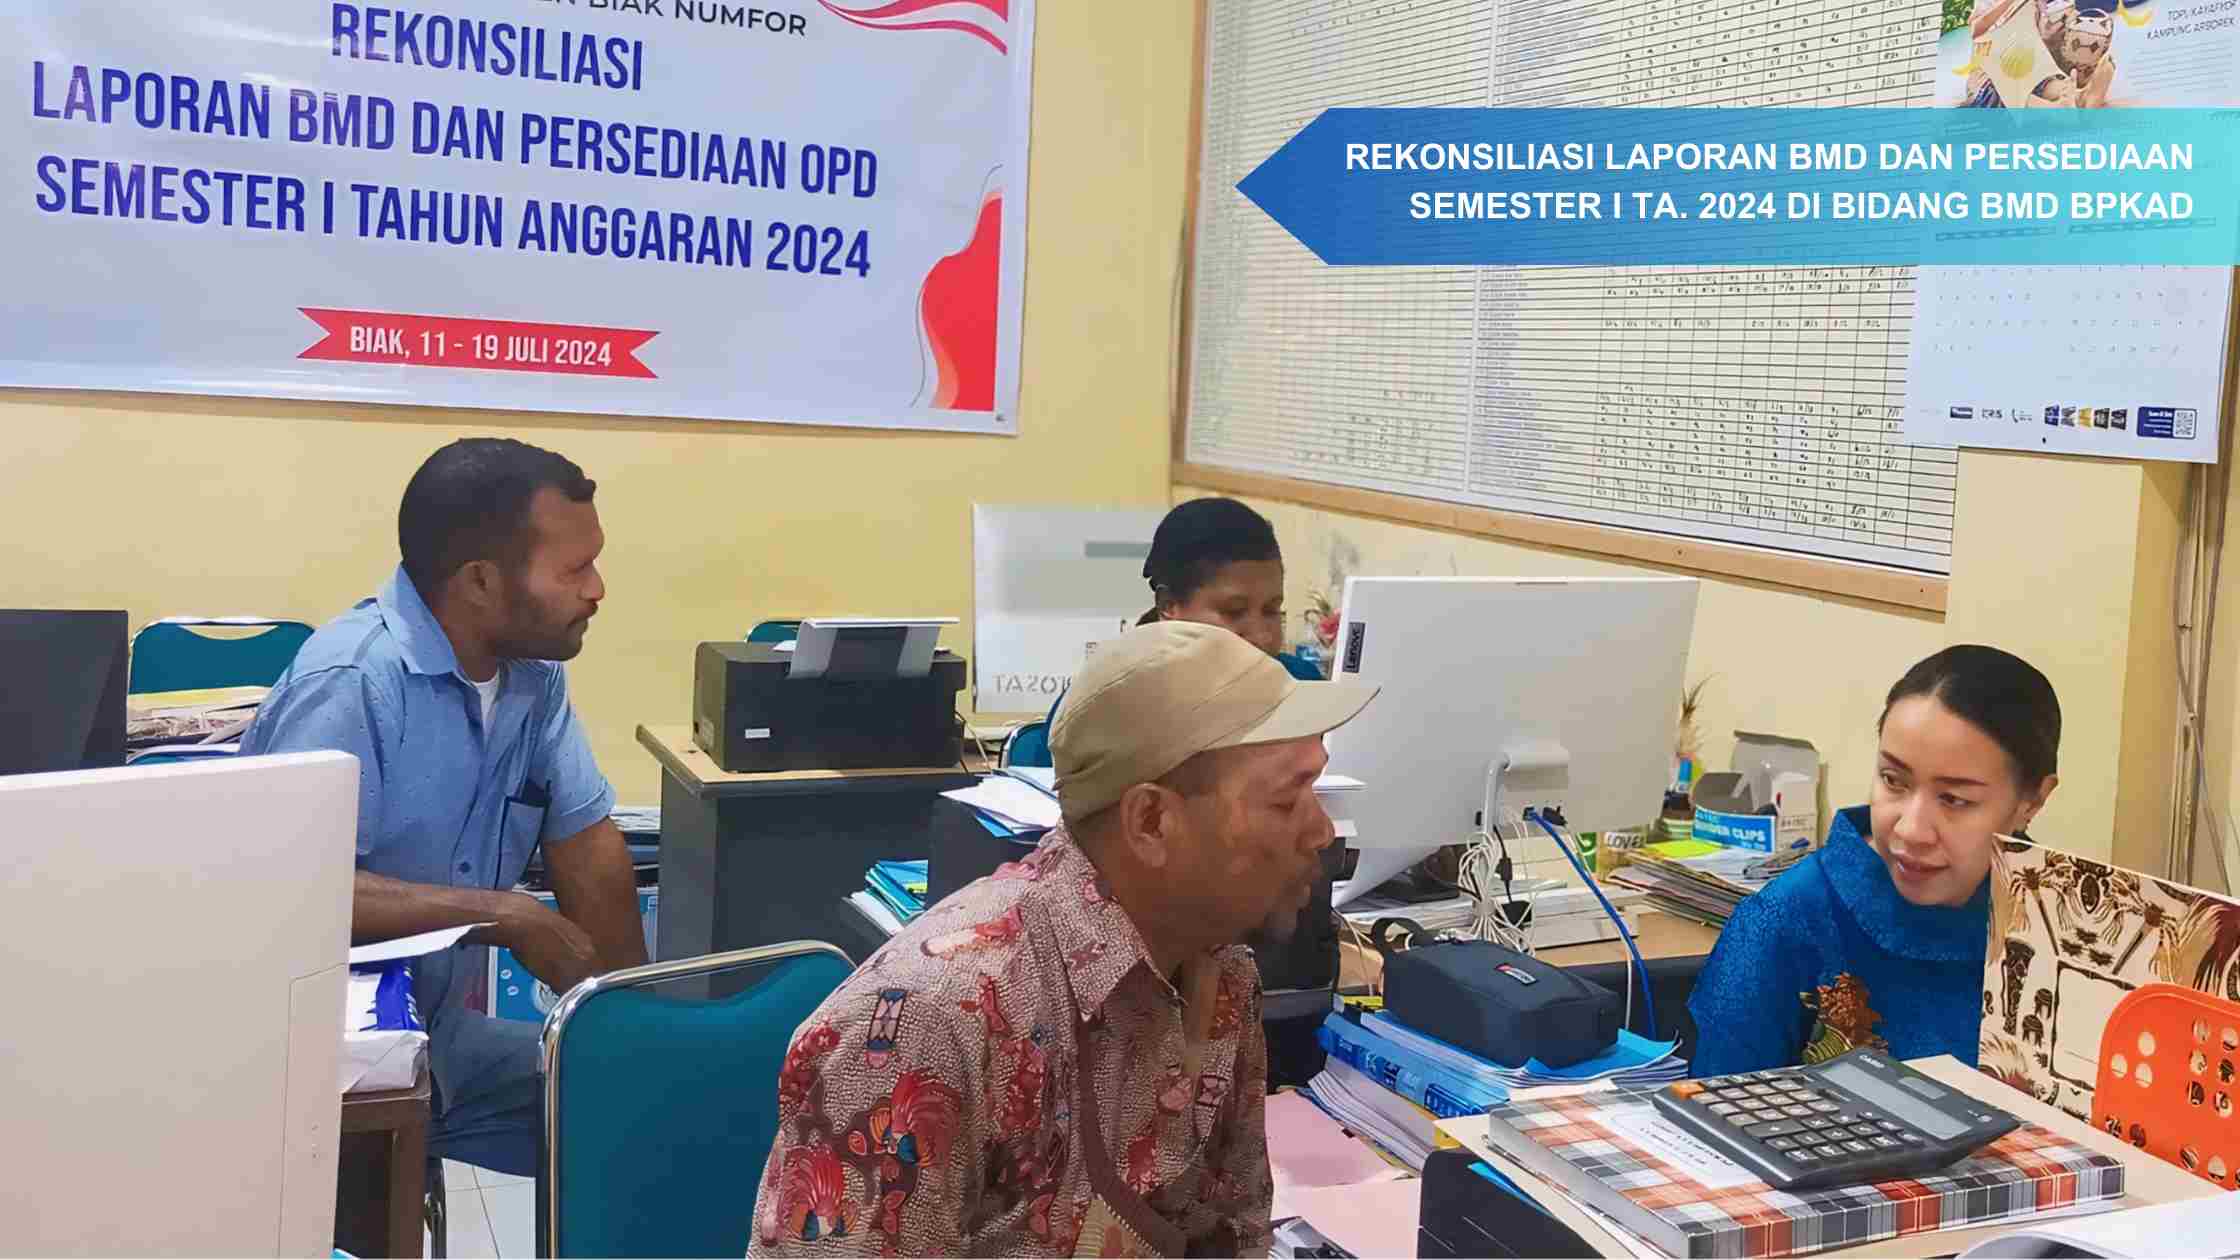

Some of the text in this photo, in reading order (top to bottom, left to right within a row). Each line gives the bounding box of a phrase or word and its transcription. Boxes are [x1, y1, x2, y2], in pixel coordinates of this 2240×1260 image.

[331, 2, 643, 91] REKONSILIASI
[675, 0, 807, 36] NUMFOR
[33, 62, 878, 199] LAPORAN BMD DAN PERSEDIAAN OPD
[35, 155, 871, 278] SEMESTER I TAHUN ANGGARAN 2024
[350, 326, 410, 358] BIAK,
[420, 331, 445, 357] 11
[473, 334, 498, 360] 19
[505, 336, 548, 363] JULI
[555, 339, 612, 366] 2024
[1731, 827, 1766, 842] CLIPS
